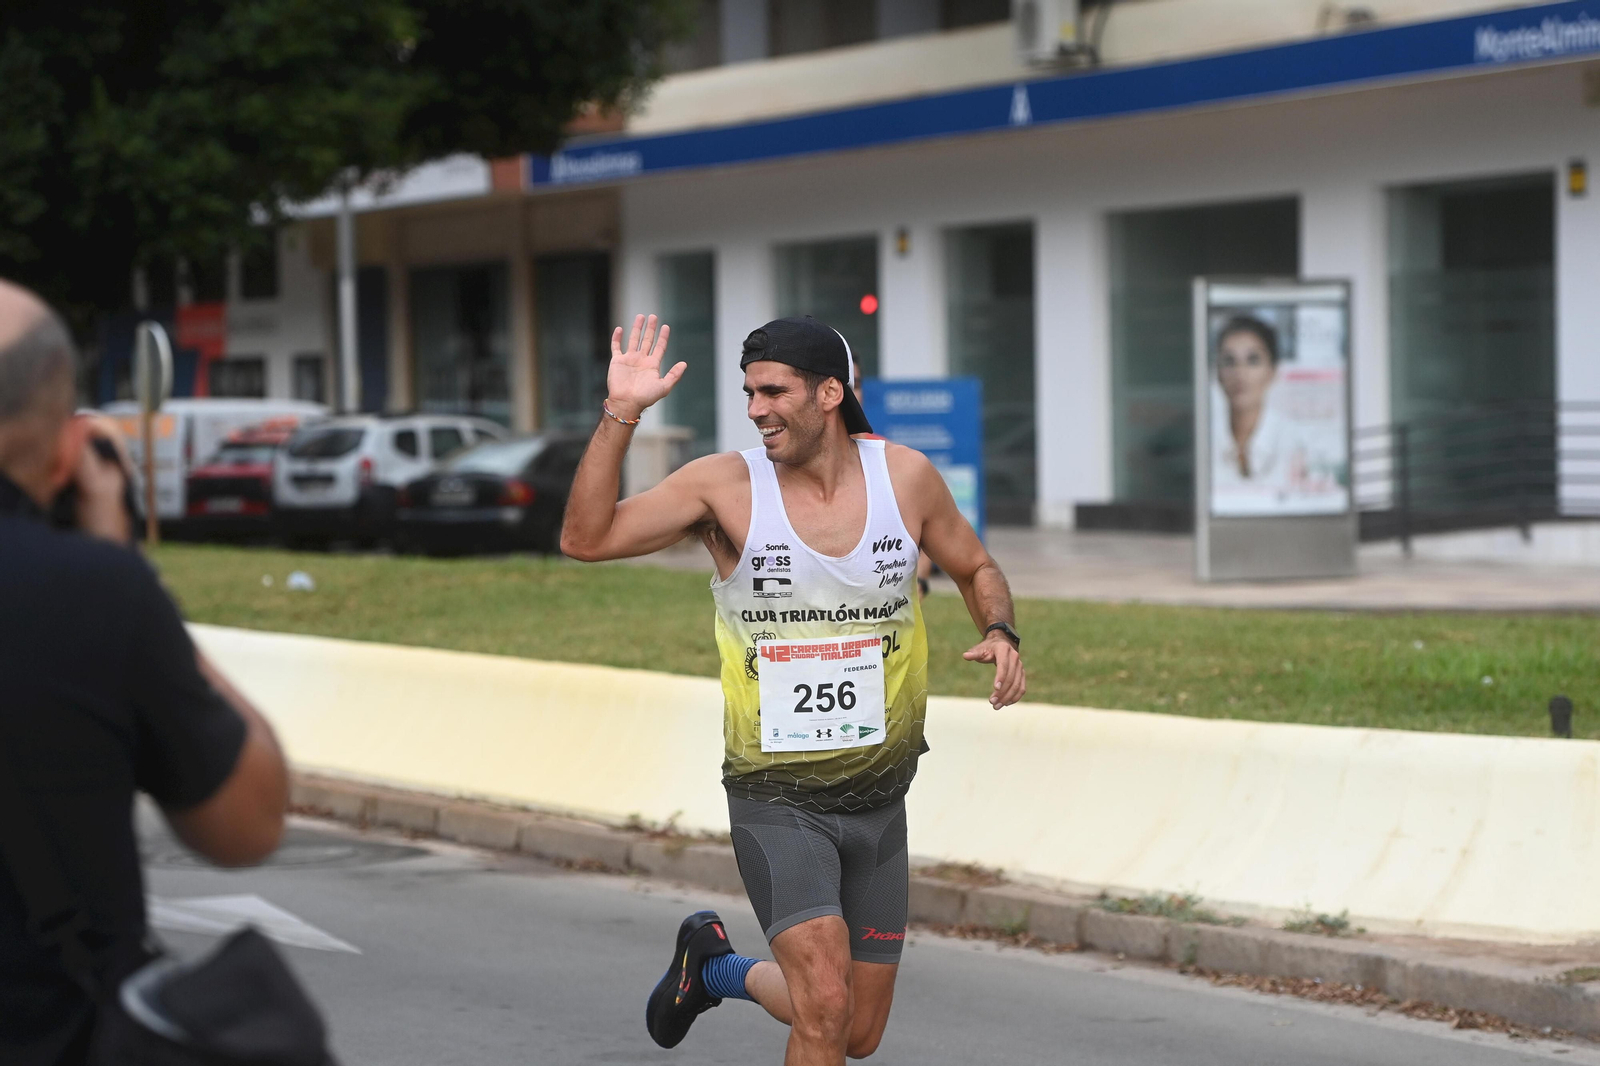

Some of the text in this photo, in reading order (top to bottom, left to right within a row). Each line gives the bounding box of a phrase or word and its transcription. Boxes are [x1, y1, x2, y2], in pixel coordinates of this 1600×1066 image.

[765, 543, 791, 551] Sonríe.
[751, 555, 791, 571] gross
[741, 609, 777, 623] CLUB
[779, 603, 860, 623] TRIATLÓN
[760, 638, 881, 662] 42 CARRERA URBANA
[843, 664, 878, 673] FEDERADO
[793, 681, 857, 713] 256
